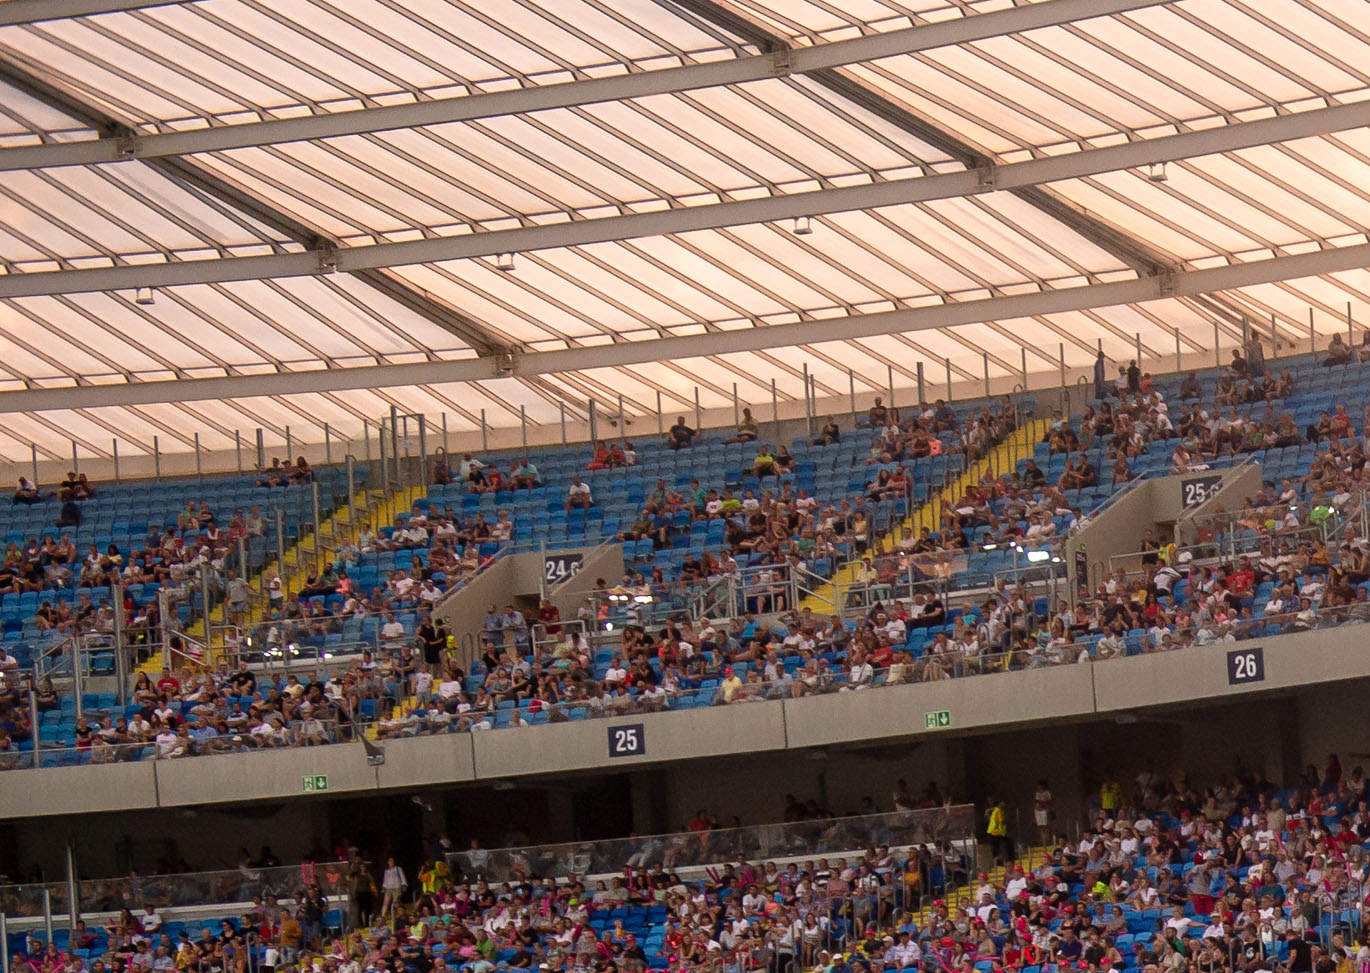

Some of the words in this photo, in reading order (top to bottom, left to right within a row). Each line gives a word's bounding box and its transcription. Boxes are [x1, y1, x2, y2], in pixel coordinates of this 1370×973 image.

[1185, 483, 1206, 504] 25
[546, 560, 567, 579] 24
[1235, 654, 1257, 678] 26
[615, 729, 637, 752] 25
